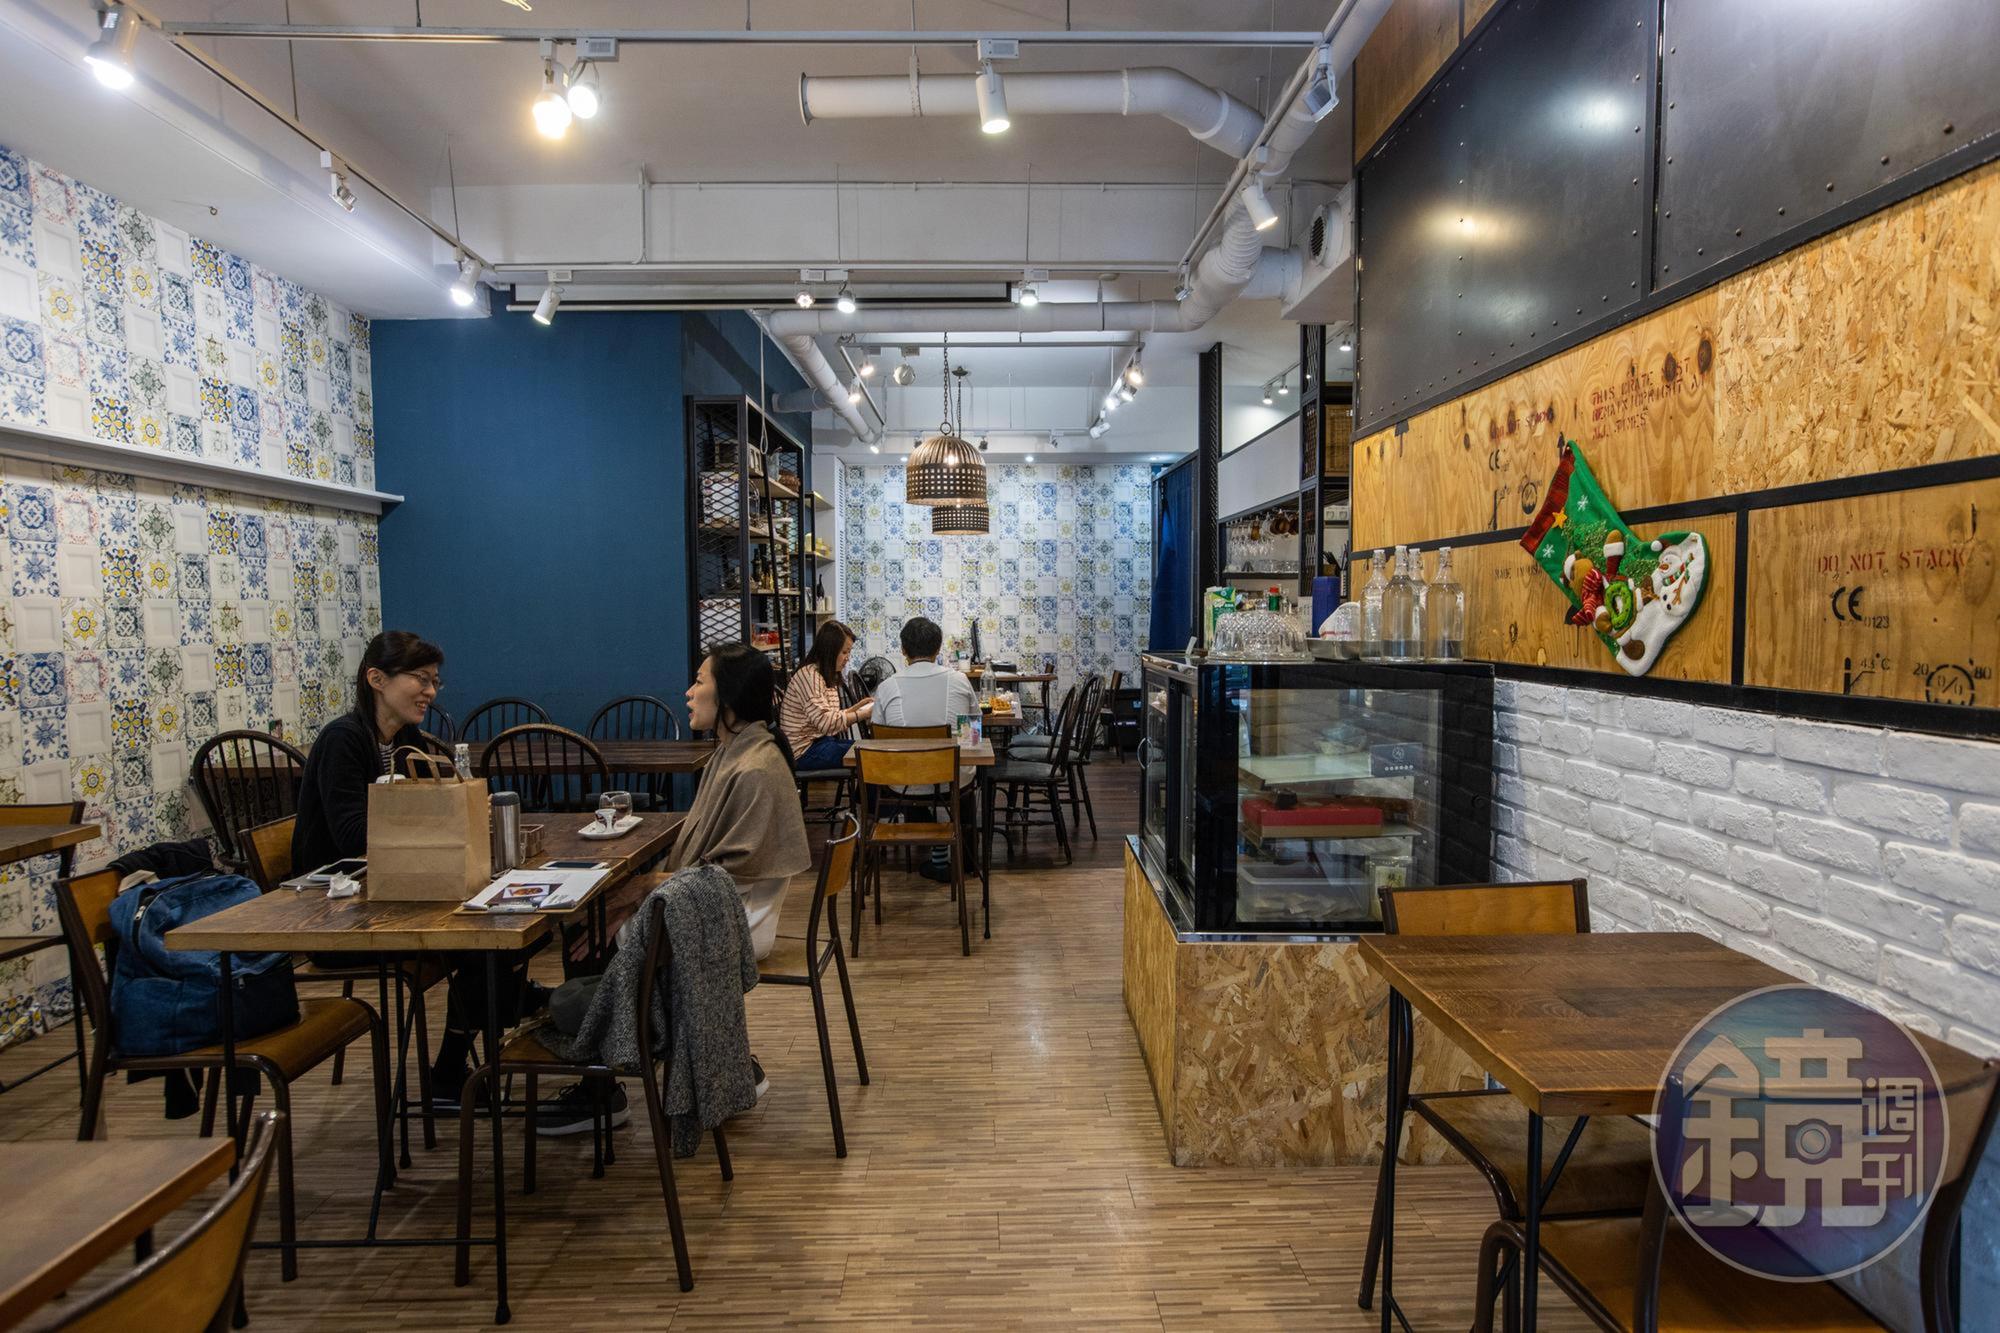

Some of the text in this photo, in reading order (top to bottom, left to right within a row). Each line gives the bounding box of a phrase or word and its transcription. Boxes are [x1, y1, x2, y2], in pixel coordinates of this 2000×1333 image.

[1818, 550, 1965, 573] DO NOT STACK
[1832, 586, 1863, 621] CE
